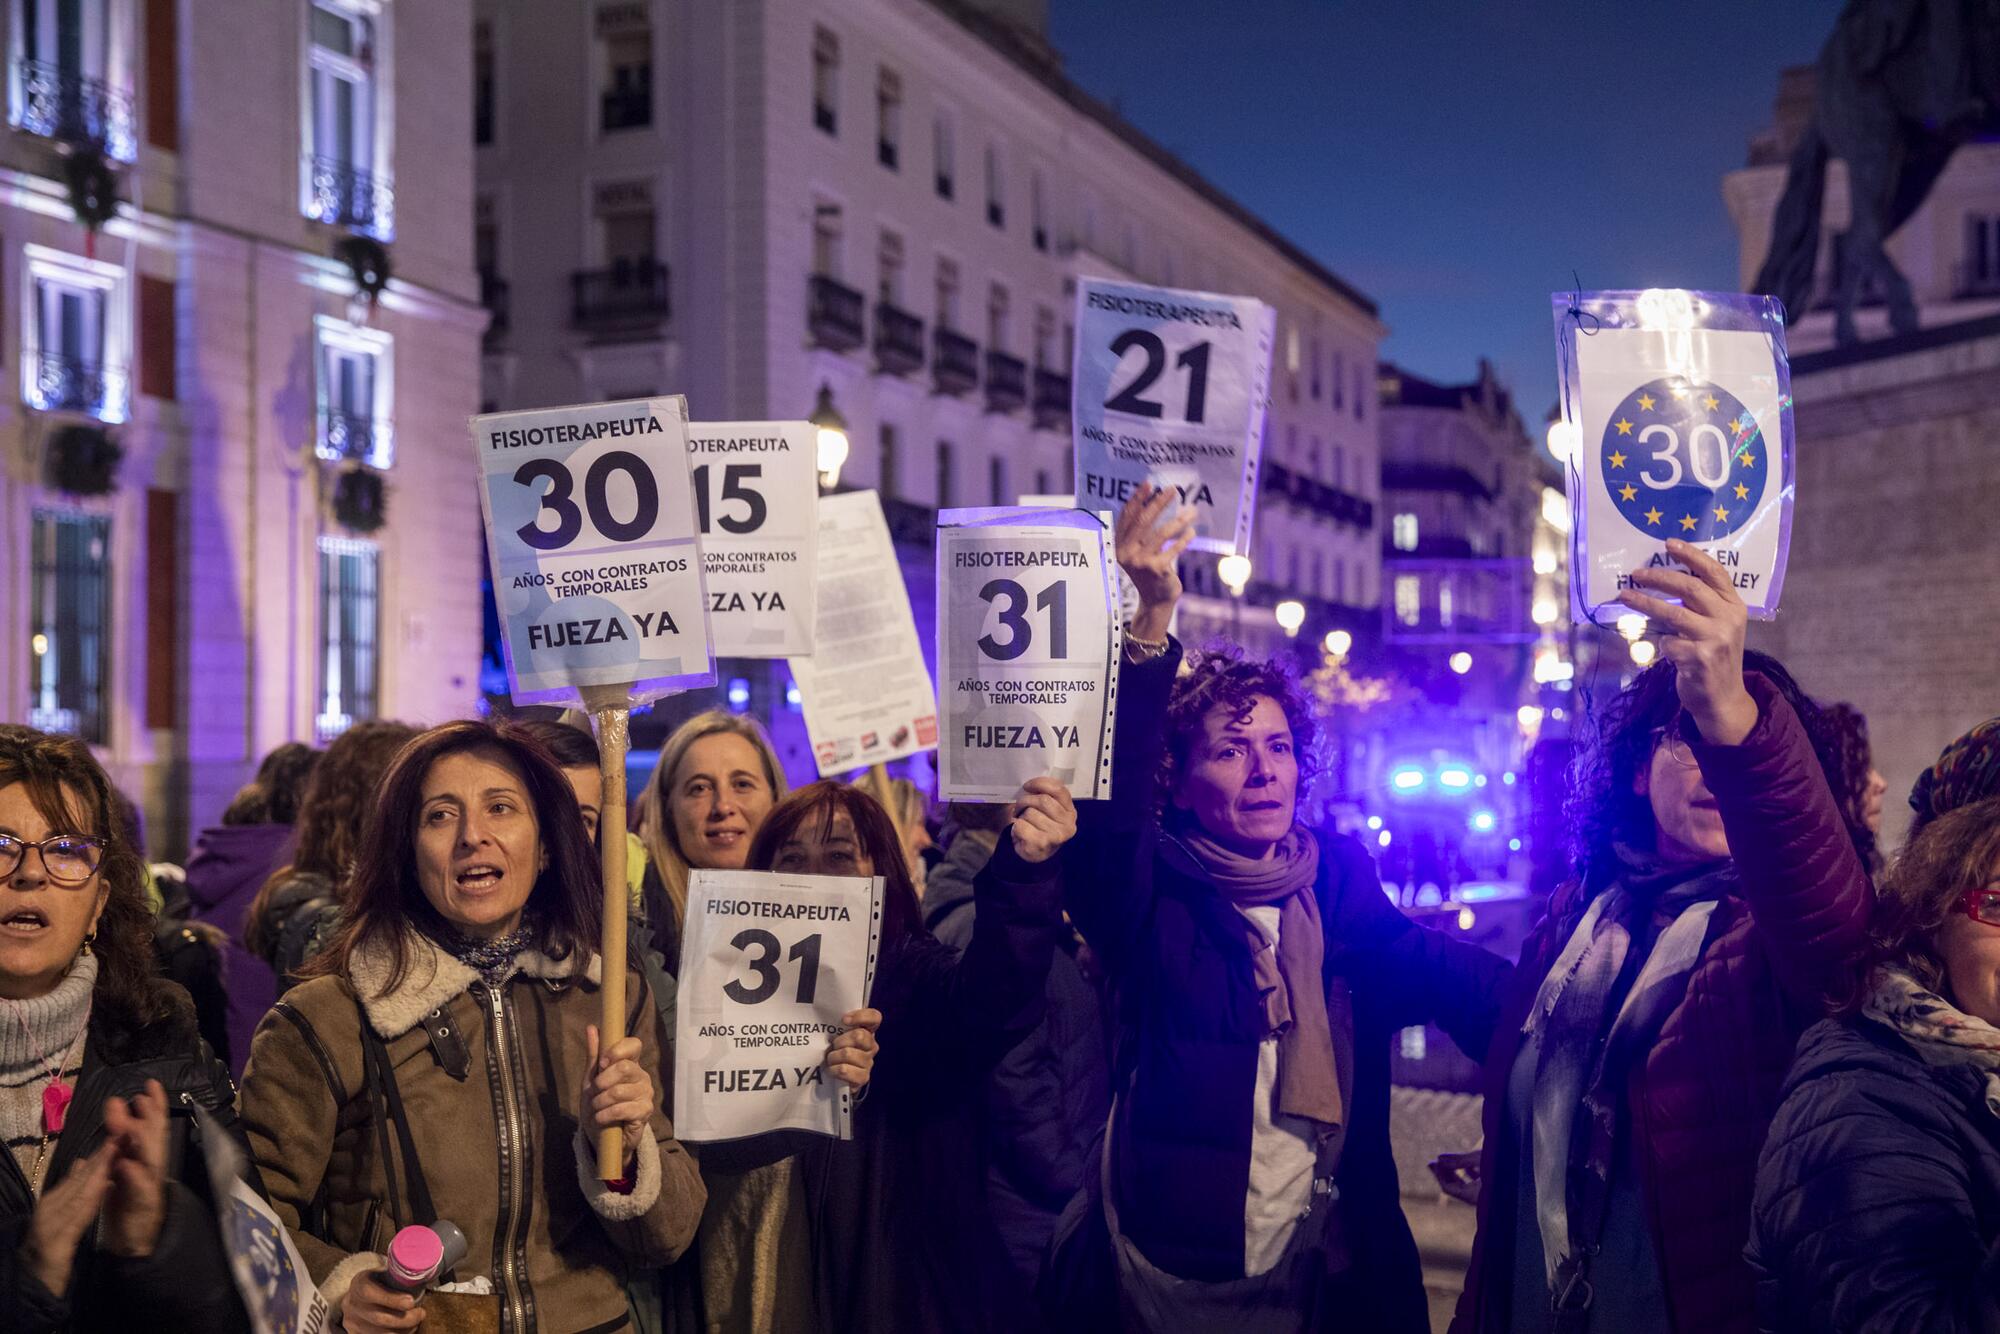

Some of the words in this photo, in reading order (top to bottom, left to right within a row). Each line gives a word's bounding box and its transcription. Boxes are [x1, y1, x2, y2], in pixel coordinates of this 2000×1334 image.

[1103, 328, 1213, 425] 21
[490, 416, 664, 450] FISIOTERAPEUTA
[1081, 424, 1115, 445] AÑOS
[1119, 435, 1148, 450] CON
[687, 438, 790, 453] OTERAPEUTA
[1637, 423, 1730, 491] 30
[513, 451, 660, 551] 30
[691, 464, 767, 535] 15
[1176, 482, 1214, 507] YA
[704, 563, 766, 574] MPORALES
[727, 551, 798, 563] CONTRATOS
[955, 551, 1090, 569] FISIOTERAPEUTA
[1717, 550, 1740, 566] EN
[512, 572, 555, 589] AÑOS
[561, 568, 595, 584] CON
[597, 558, 688, 580] CONTRATOS
[1732, 572, 1761, 589] LEY
[554, 577, 649, 599] TEMPORALES
[751, 591, 786, 611] YA
[527, 617, 629, 650] FIJEZA
[632, 610, 680, 638] YA
[977, 578, 1068, 662] 31
[957, 677, 991, 692] AÑOS
[995, 680, 1023, 692] CON
[1025, 680, 1096, 692] CONTRATOS
[988, 692, 1068, 704] TEMPORALES
[964, 725, 1046, 748] FIJEZA
[1051, 726, 1080, 748] YA
[706, 899, 851, 922] FISIOTERAPEUTA
[722, 928, 823, 1005] 31
[699, 1023, 735, 1037] AÑOS
[740, 1024, 768, 1036] CON
[770, 1023, 845, 1036] CONTRATOS
[733, 1035, 811, 1048] TEMPORALES
[703, 1068, 788, 1093] FIJEZA
[793, 1065, 824, 1087] YA
